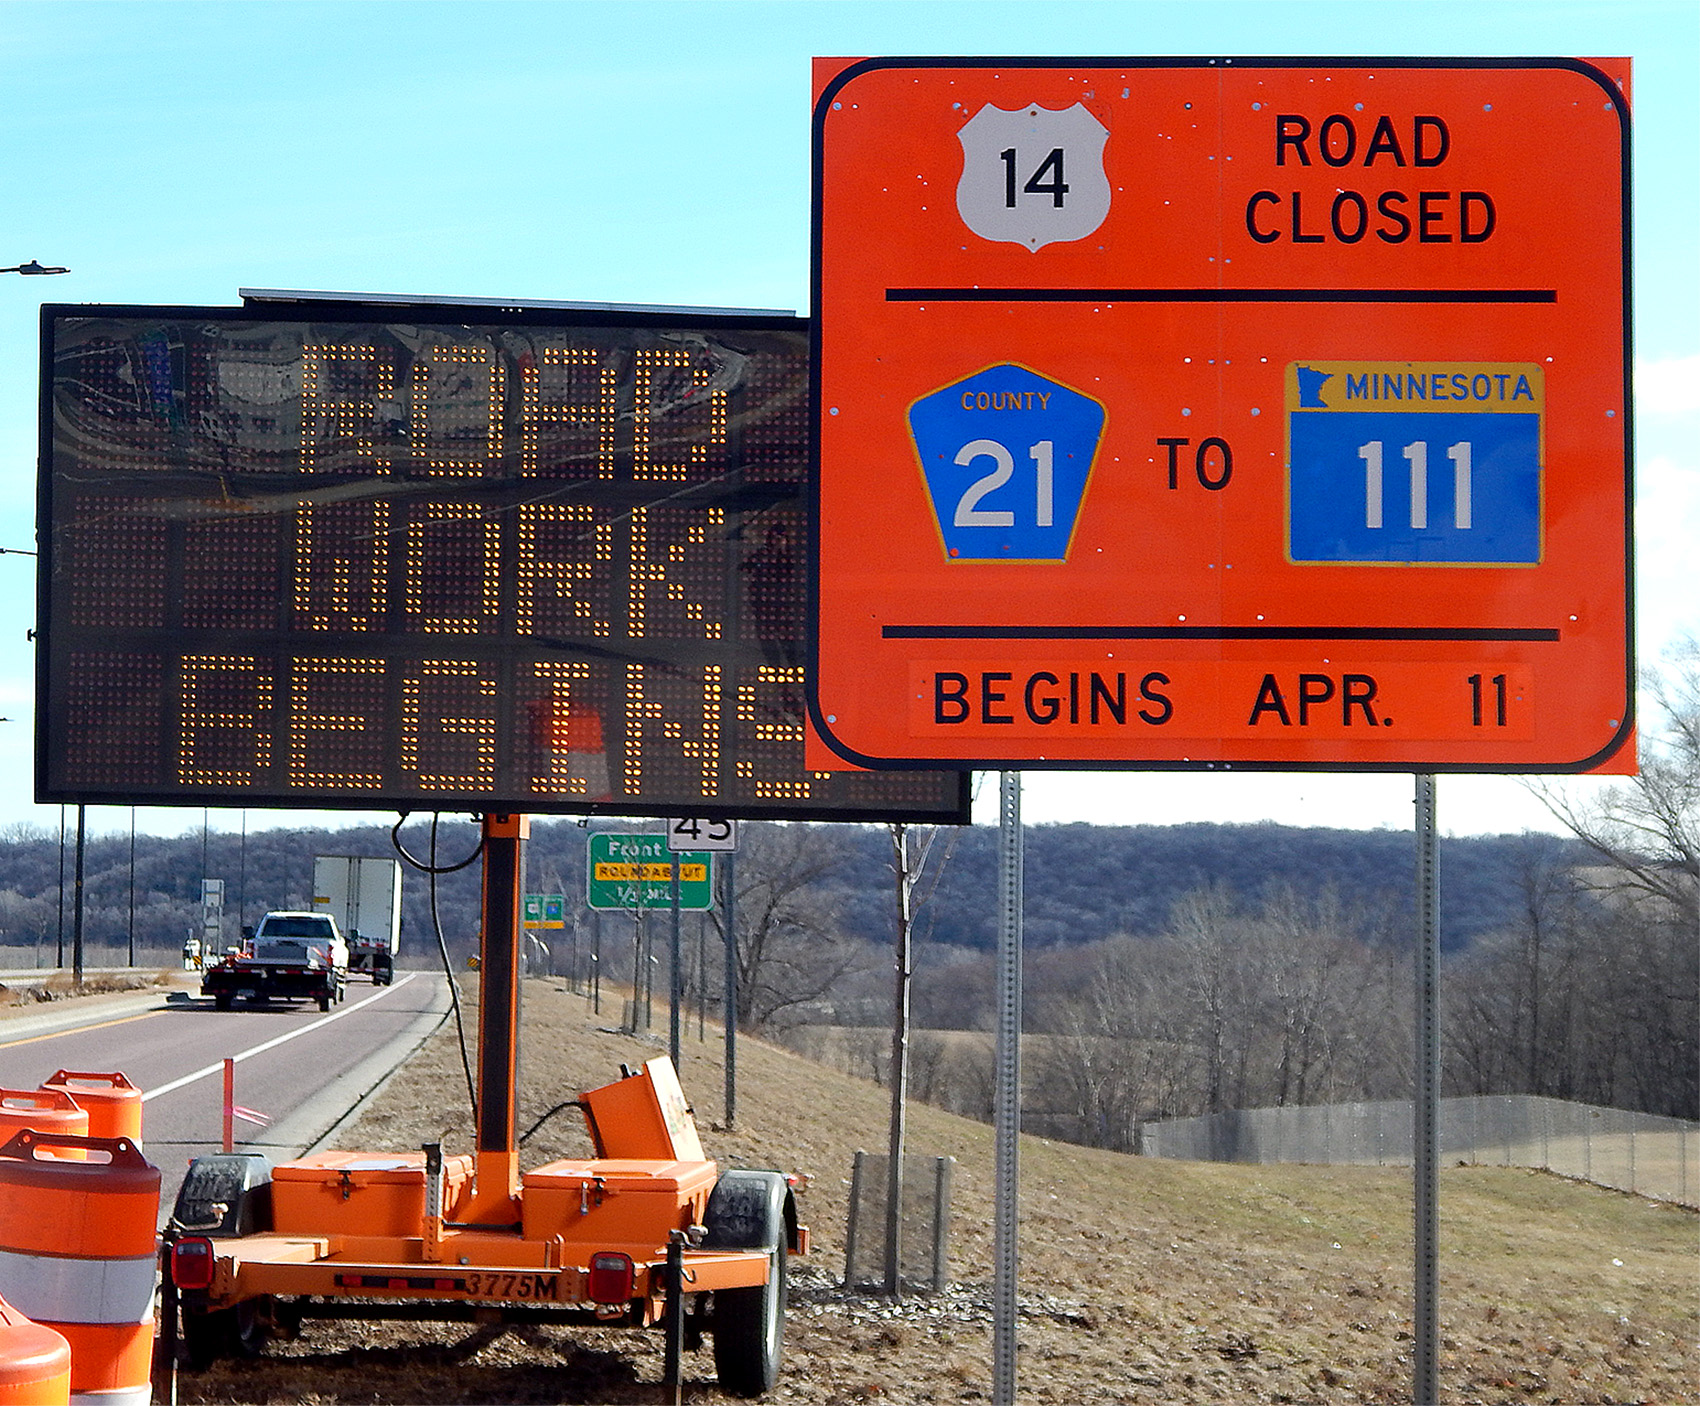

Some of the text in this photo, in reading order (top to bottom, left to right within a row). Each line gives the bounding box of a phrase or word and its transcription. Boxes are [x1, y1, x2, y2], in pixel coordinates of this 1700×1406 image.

[1276, 114, 1450, 168] ROAD
[1000, 147, 1070, 209] 14
[1245, 190, 1496, 245] CLOSED
[300, 344, 728, 481] ROAD
[961, 391, 1052, 411] COUNTY
[1346, 373, 1535, 402] MINNESOTA
[953, 439, 1053, 527] 21
[1156, 437, 1233, 491] TO
[1358, 440, 1472, 529] 111
[294, 499, 726, 640] WORK
[177, 654, 831, 798] BEGINS
[934, 671, 1506, 727] BEGINS APR. 11
[599, 866, 701, 879] ROUNDABUT
[608, 841, 662, 857] Front
[465, 1273, 557, 1299] 3775M
